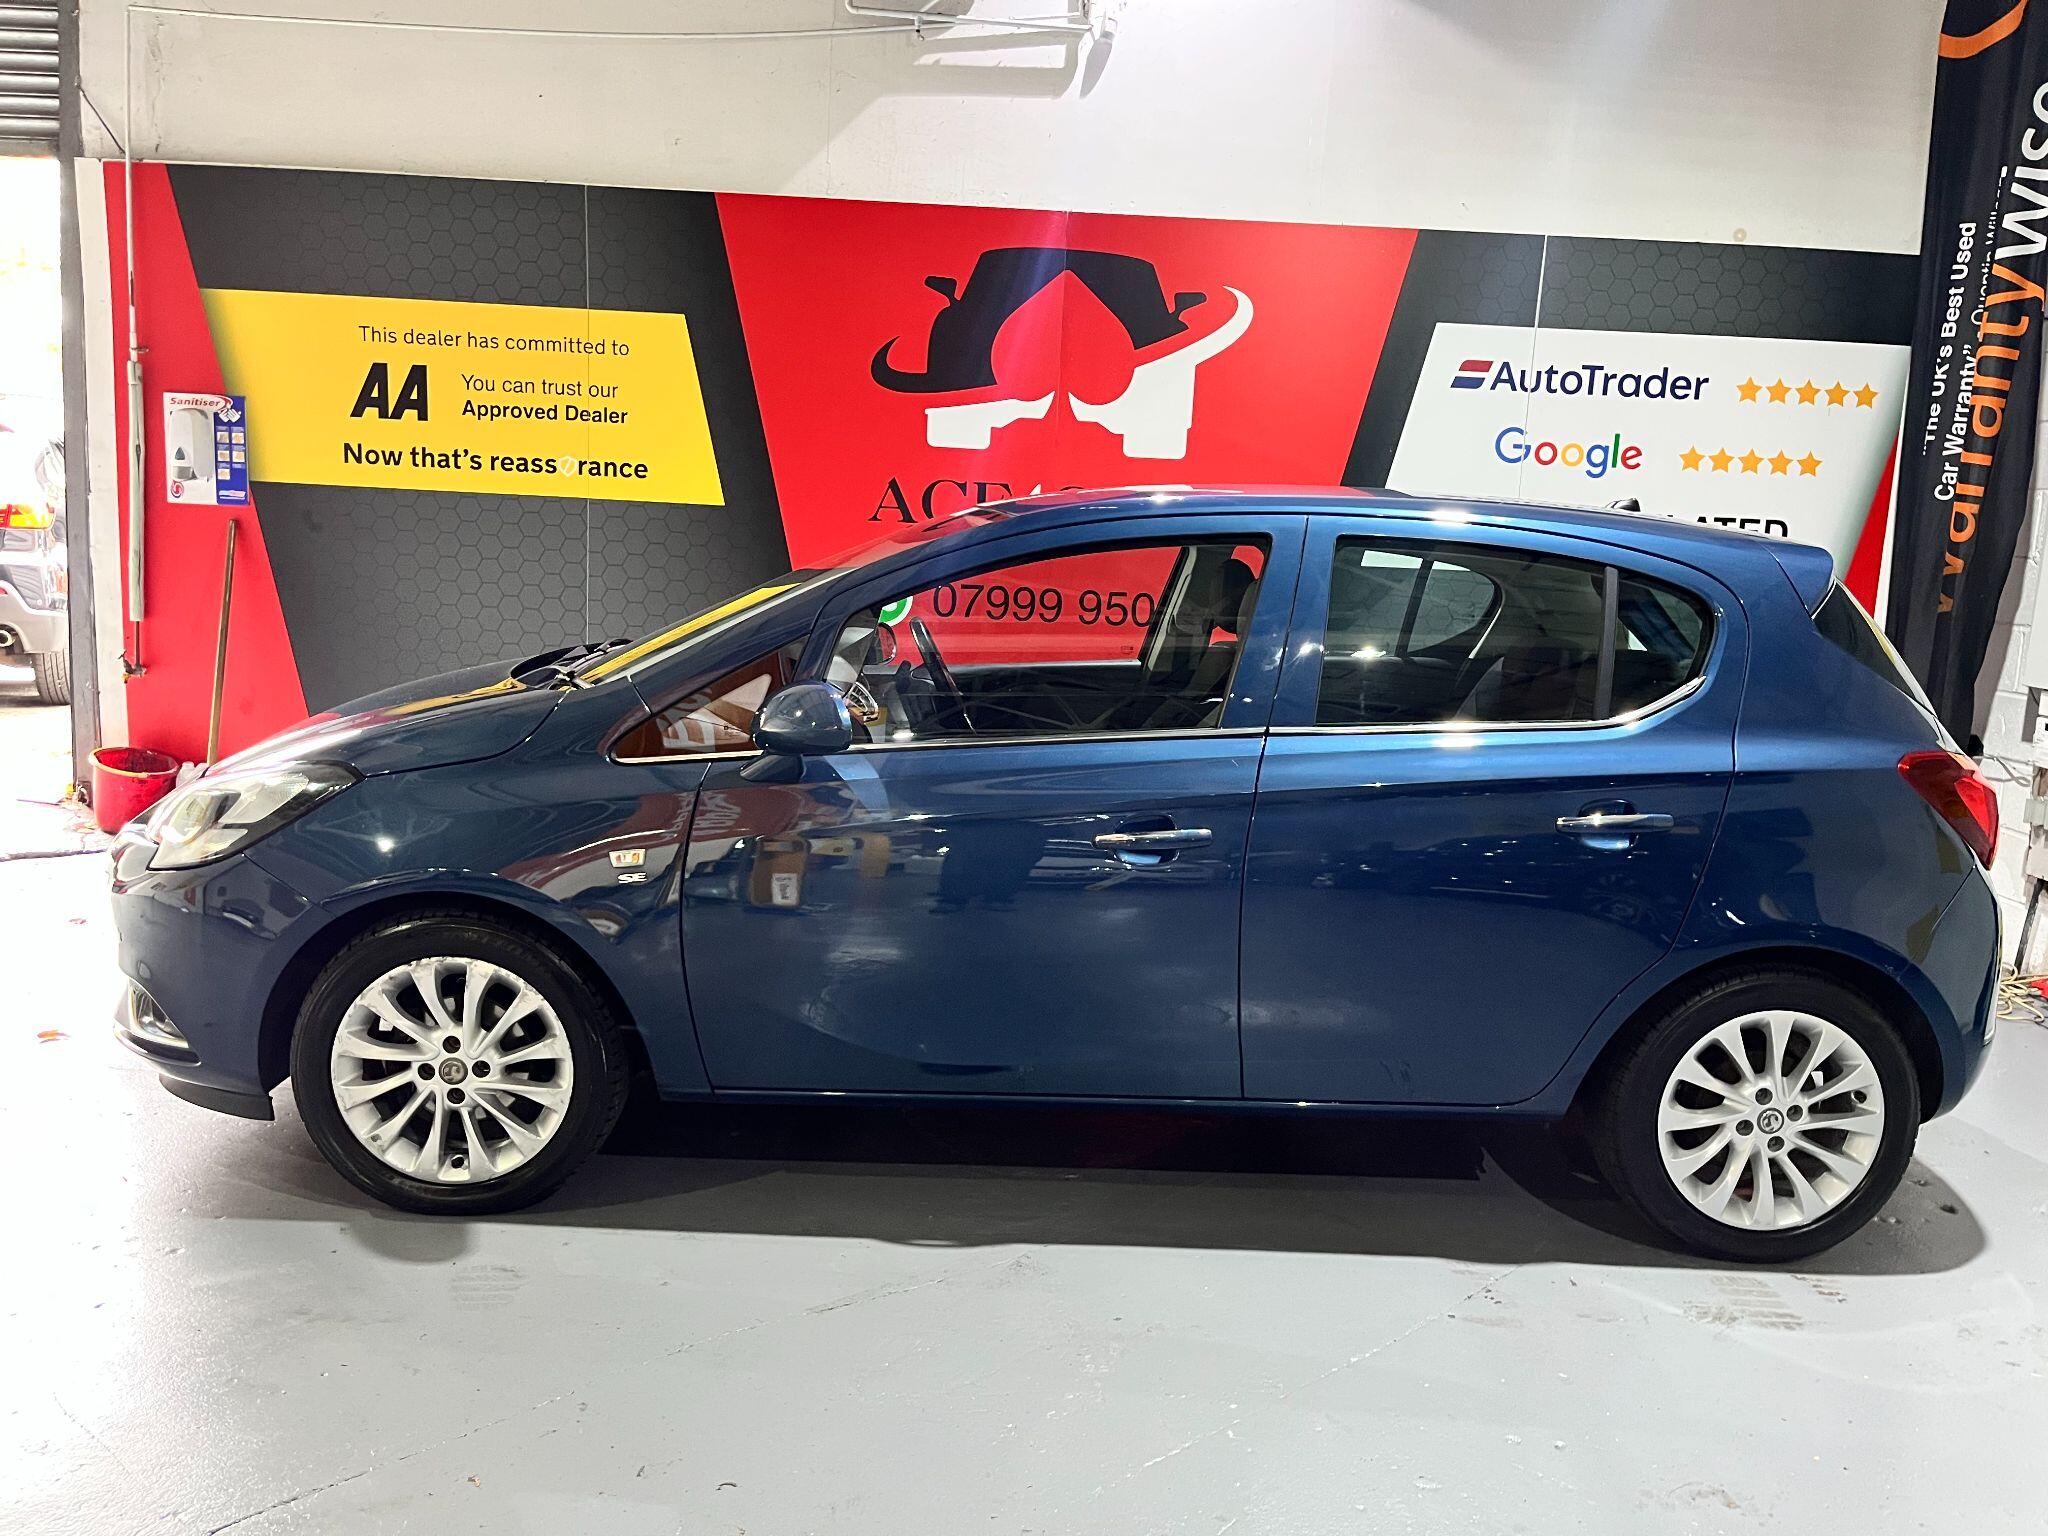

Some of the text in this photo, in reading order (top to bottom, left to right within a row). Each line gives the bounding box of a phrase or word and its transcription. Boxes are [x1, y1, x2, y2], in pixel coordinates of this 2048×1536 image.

[1950, 222, 1977, 281] Used
[1941, 286, 1965, 338] Best
[359, 325, 630, 356] This dealer has committed to
[350, 362, 428, 421] AA
[461, 374, 619, 398] You can trust our
[1490, 361, 1710, 400] AutoTrader
[170, 397, 220, 407] Sanitiser
[461, 400, 628, 424] Approved Dealer
[343, 443, 402, 466] Now
[410, 447, 482, 470] that’s
[1494, 426, 1644, 479] Google
[1934, 462, 1959, 501] Car
[933, 583, 1155, 627] 07999 950
